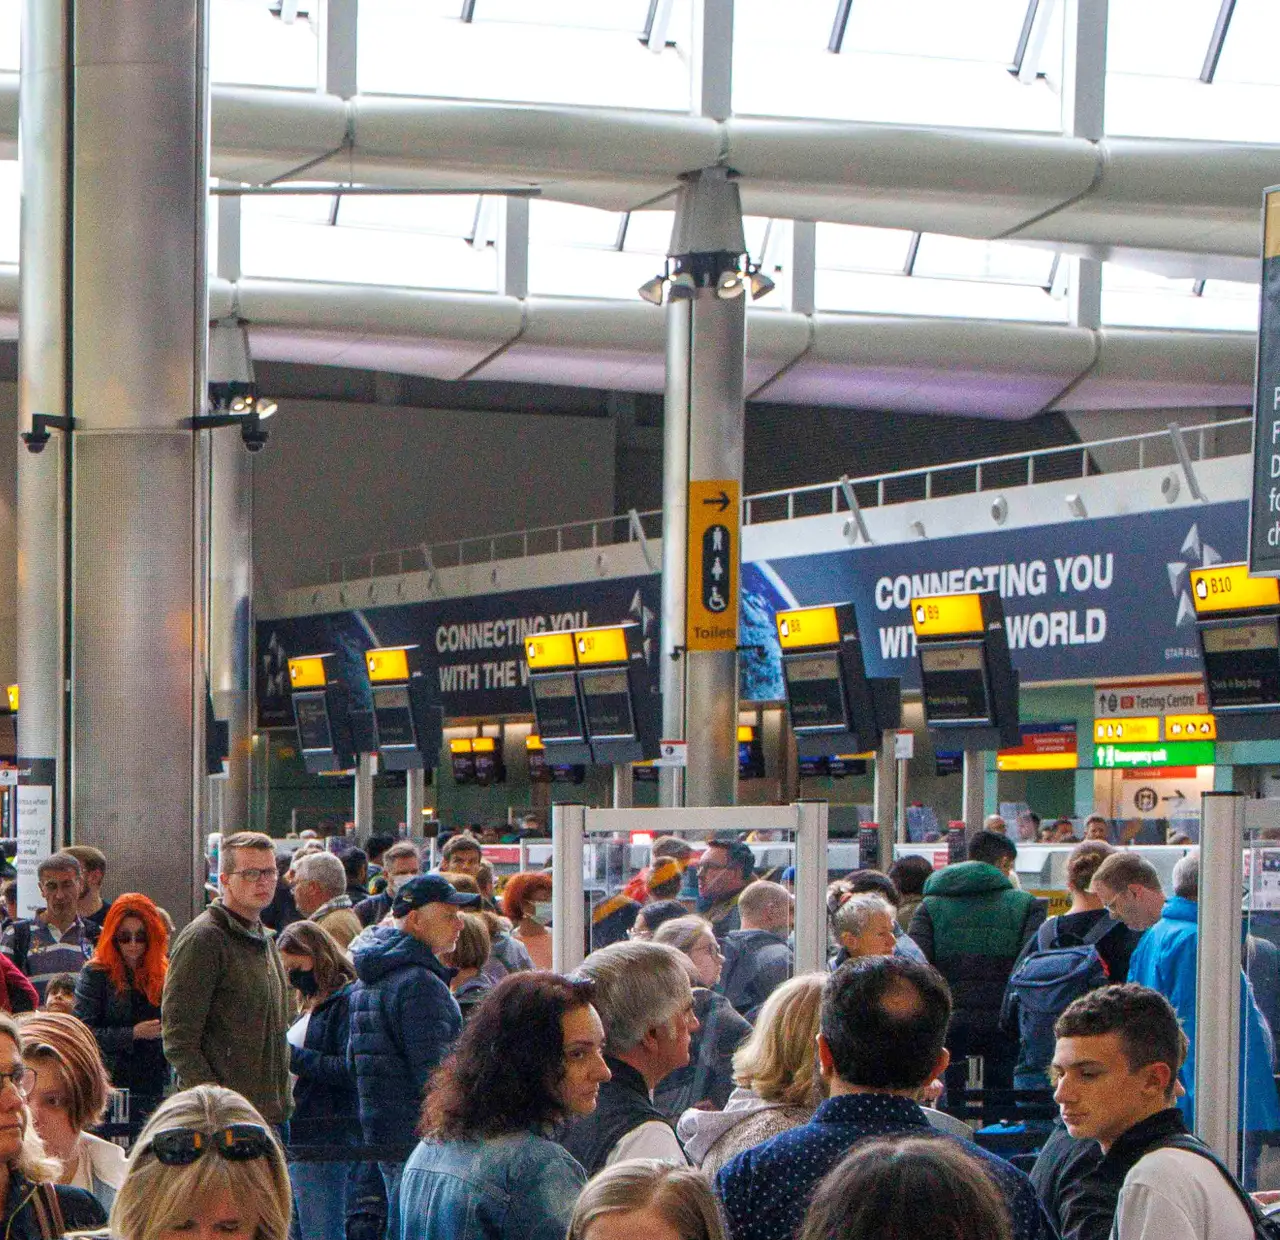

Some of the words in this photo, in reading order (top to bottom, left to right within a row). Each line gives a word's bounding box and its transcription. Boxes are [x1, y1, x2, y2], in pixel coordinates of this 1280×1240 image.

[874, 560, 1047, 611] CONNECTING
[1054, 553, 1114, 593] YOU
[1211, 576, 1232, 594] B10
[927, 604, 940, 620] B9
[435, 615, 547, 653] CONNECTING
[693, 625, 737, 640] Toilets
[879, 625, 918, 660] WIT
[1005, 608, 1108, 650] WORLD
[439, 663, 480, 692] WITH
[483, 659, 517, 690] THE
[1136, 695, 1165, 711] Testing
[1167, 693, 1195, 708] Centre
